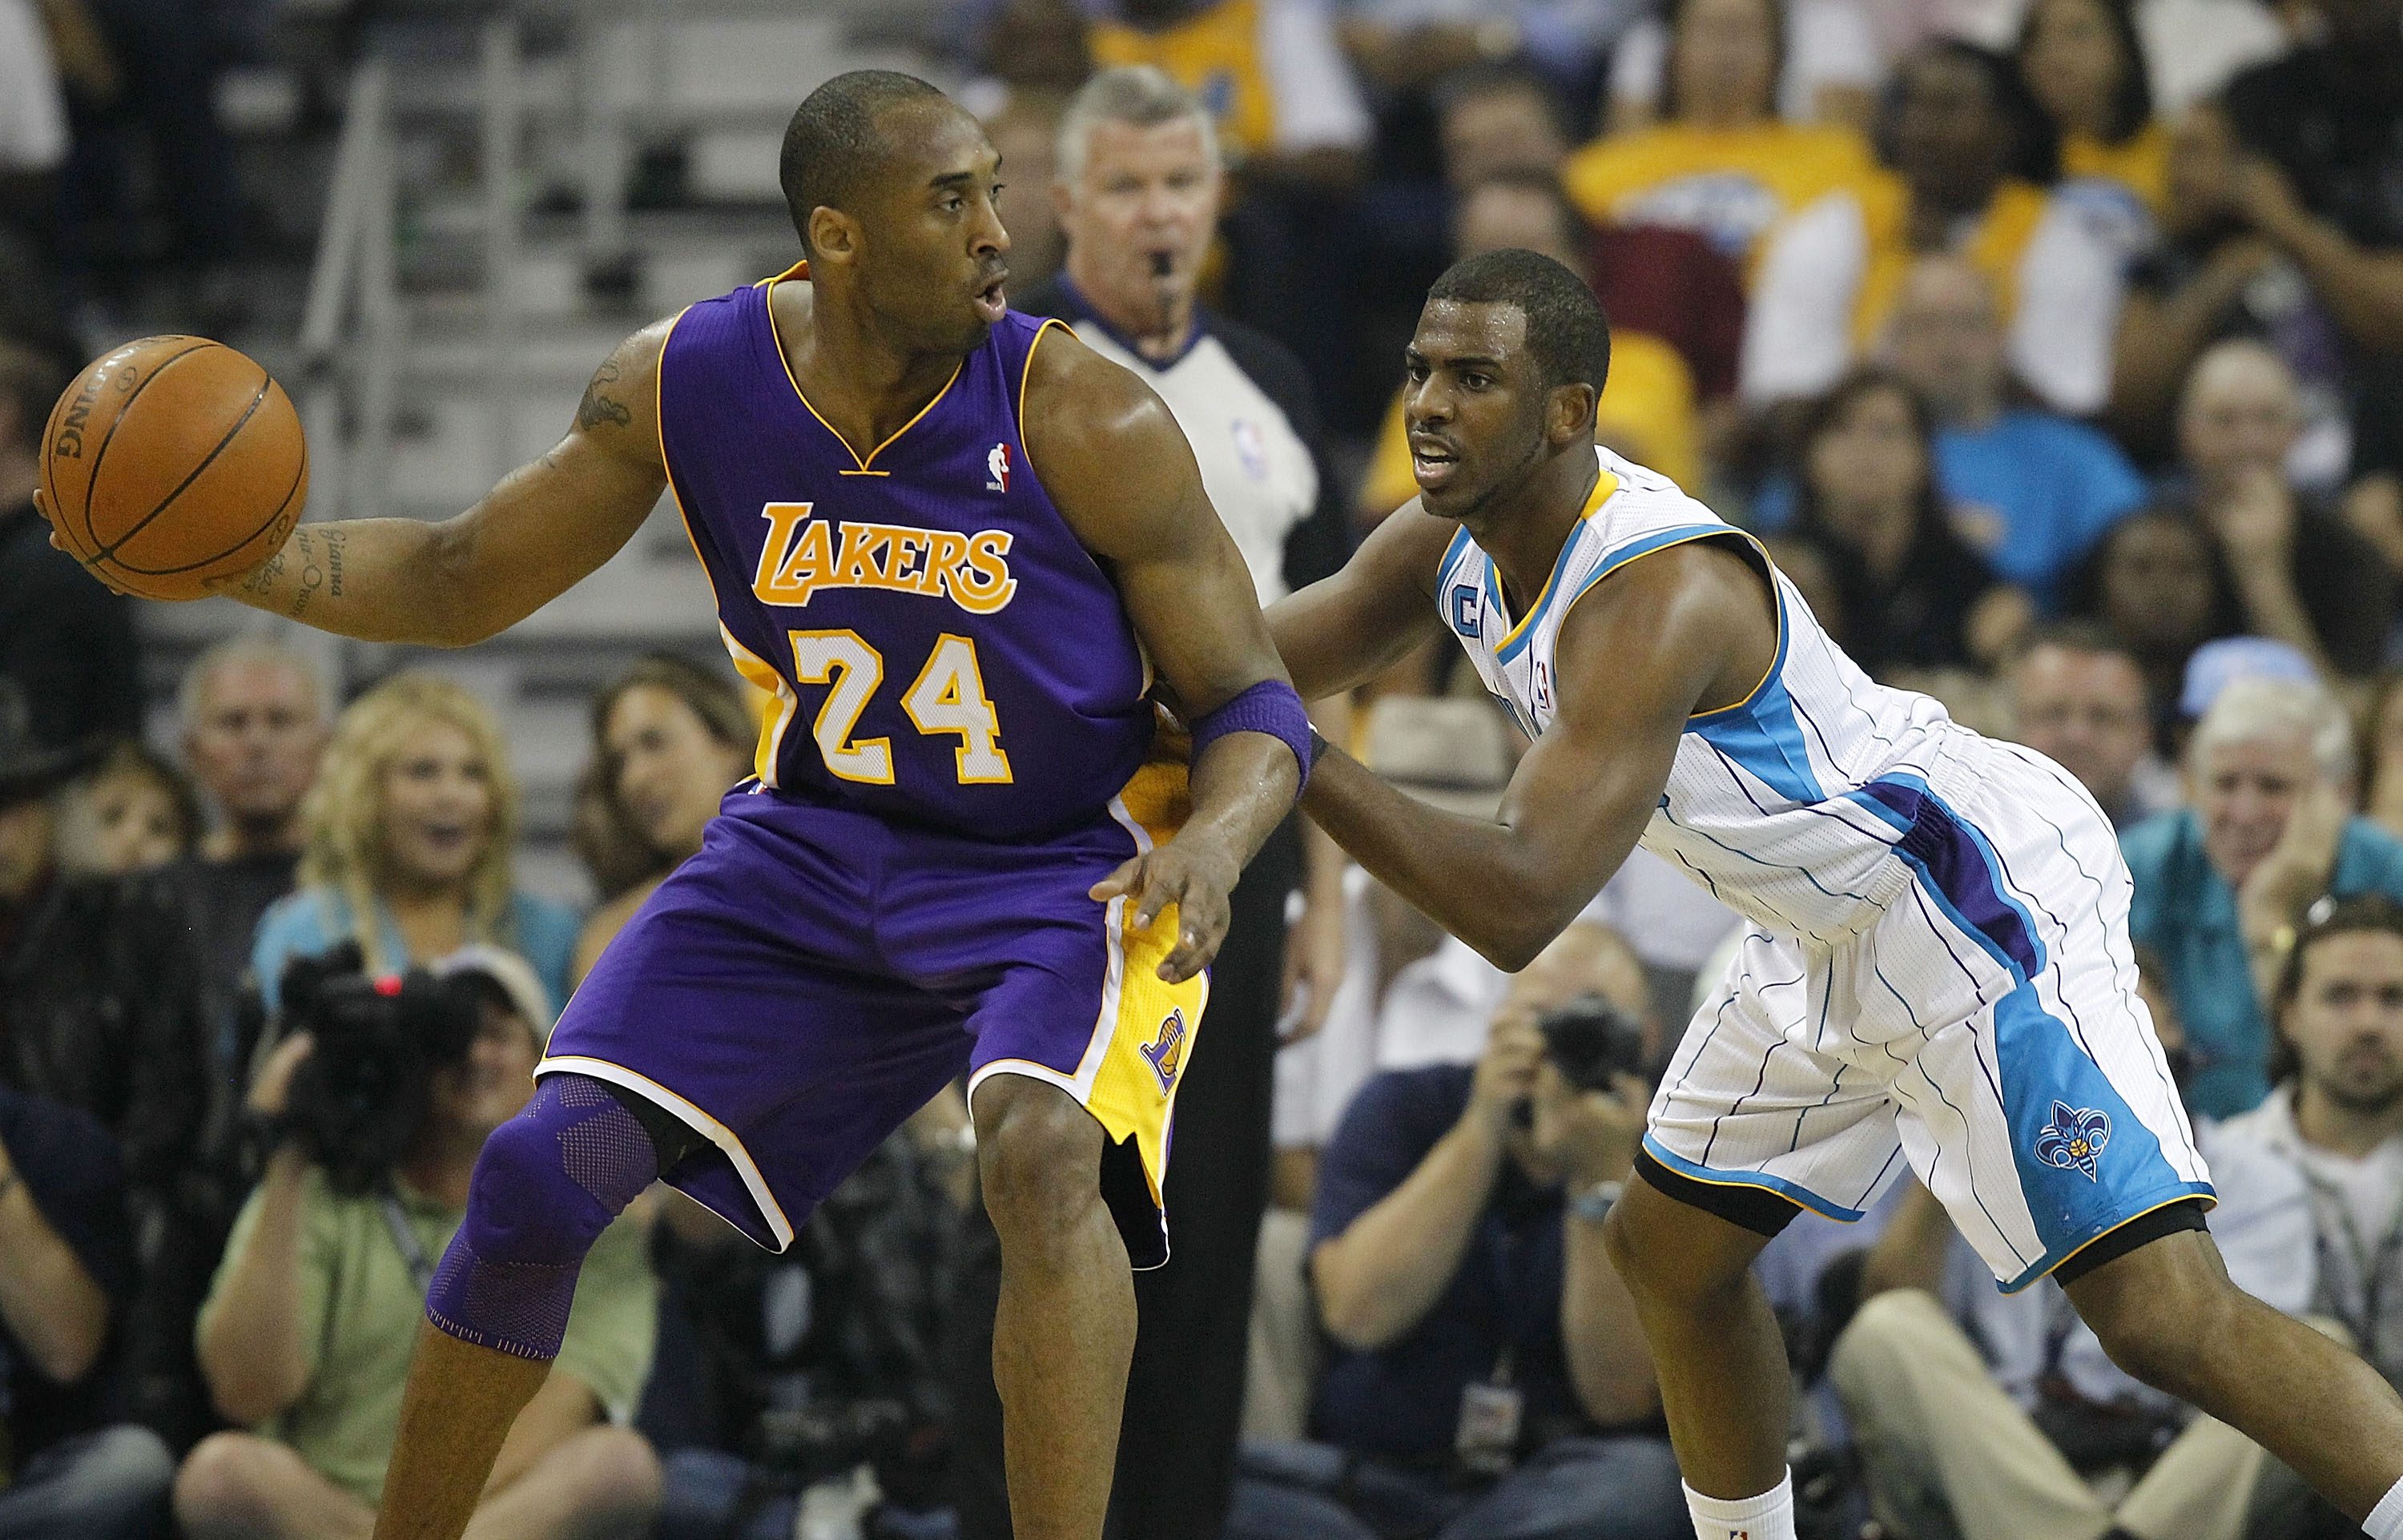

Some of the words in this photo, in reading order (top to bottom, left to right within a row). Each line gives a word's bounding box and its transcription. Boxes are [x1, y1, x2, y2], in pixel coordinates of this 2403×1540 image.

[318, 529, 346, 597] Gianna
[751, 501, 1017, 615] LAKERS
[1452, 584, 1480, 639] C
[787, 629, 1013, 786] 24
